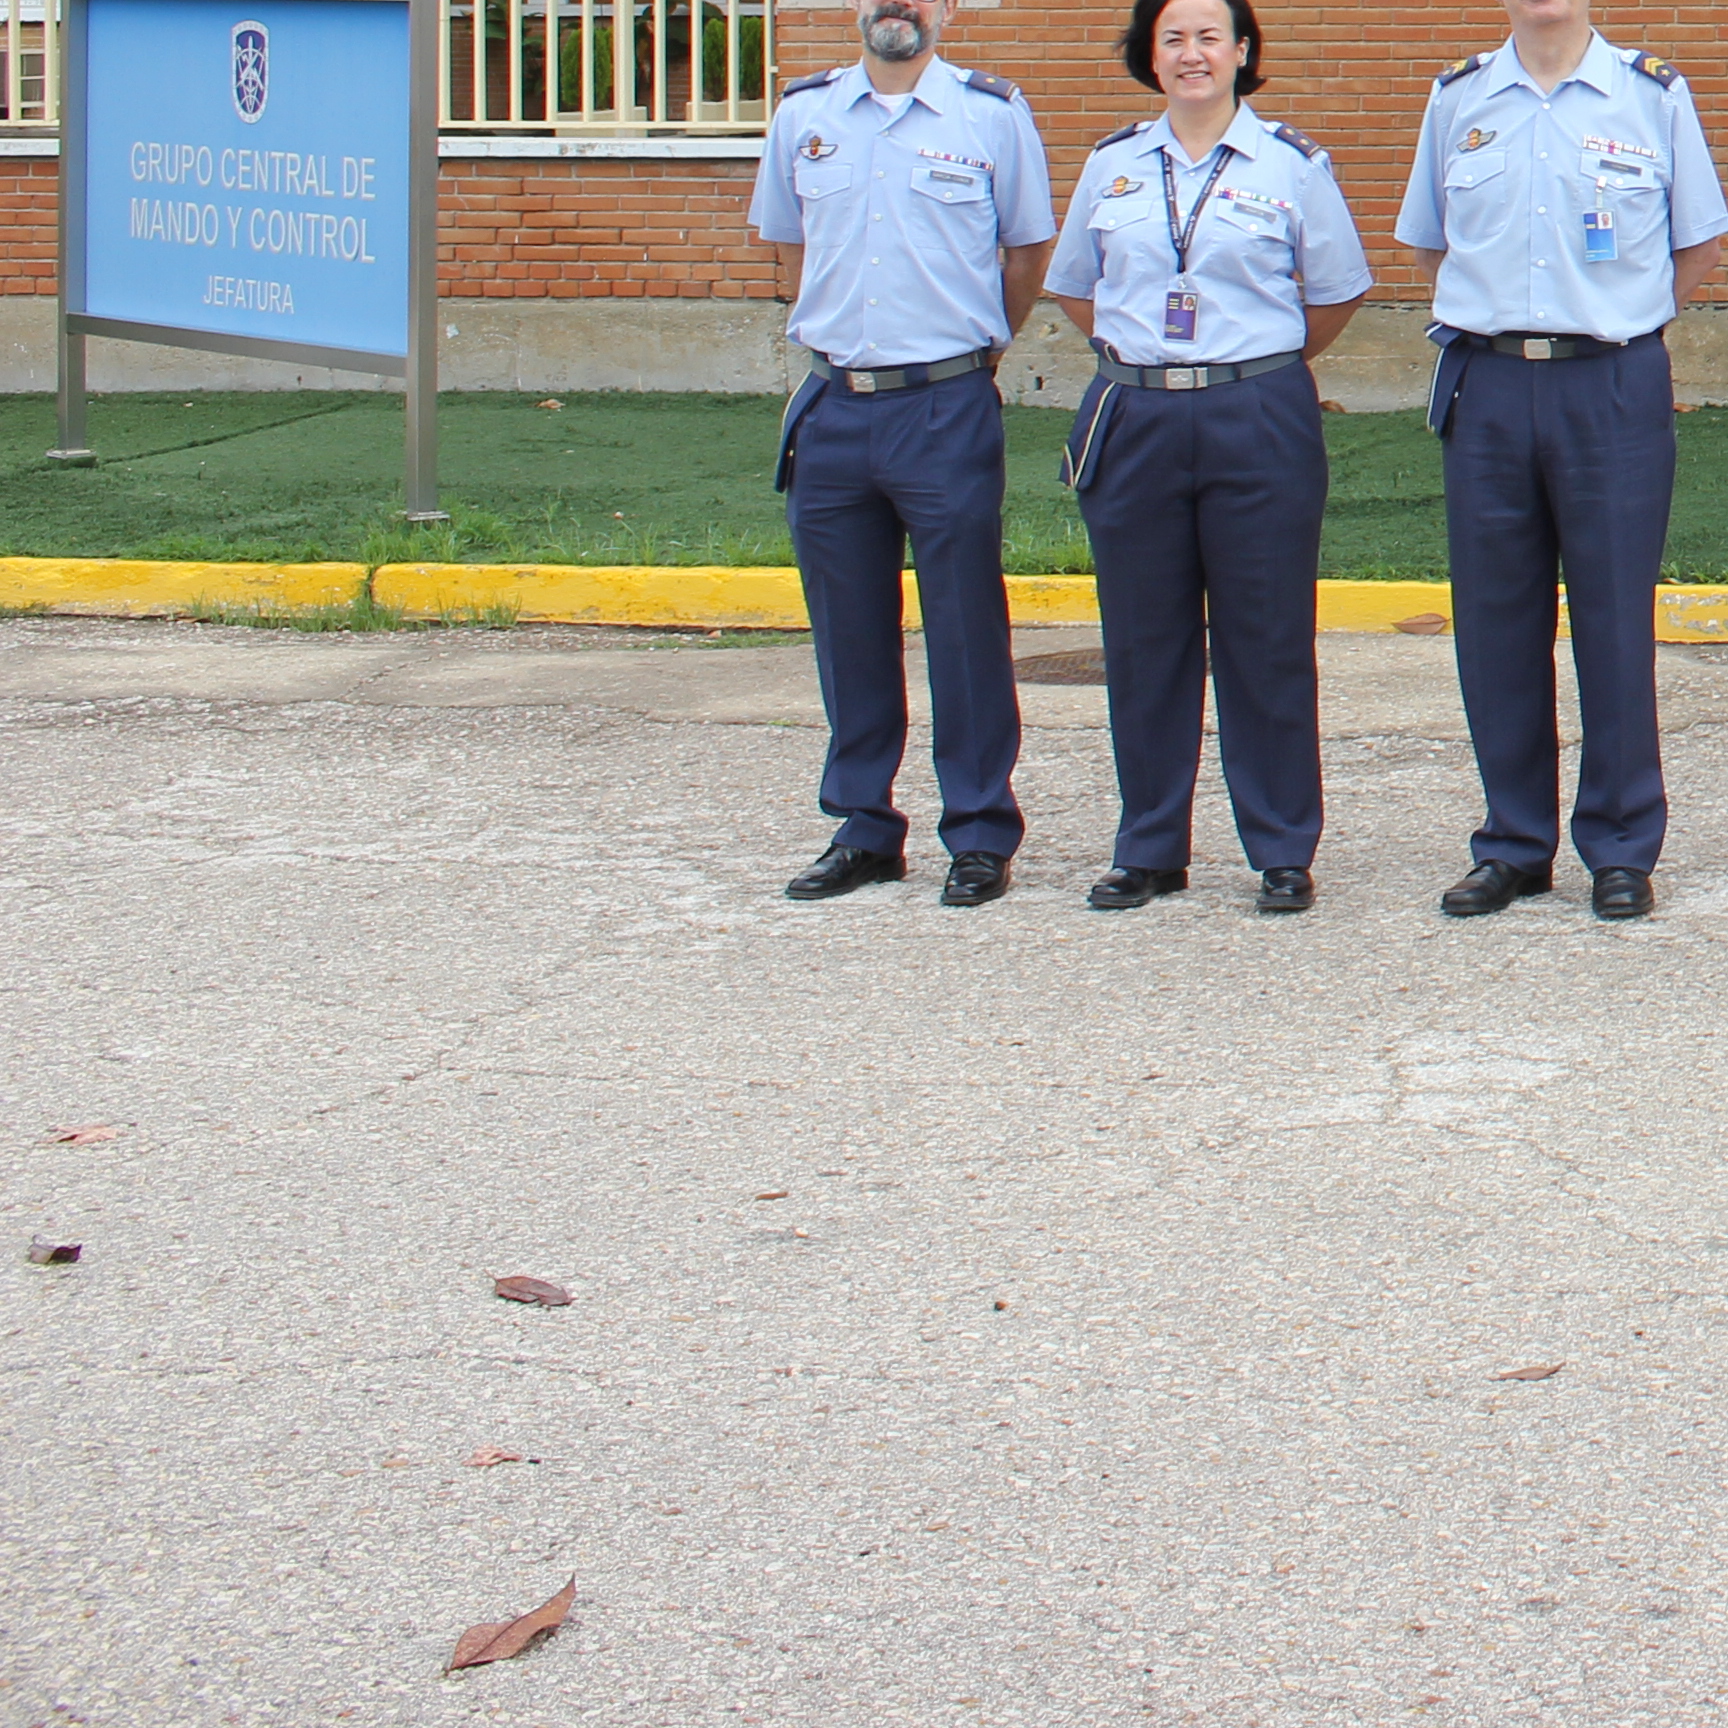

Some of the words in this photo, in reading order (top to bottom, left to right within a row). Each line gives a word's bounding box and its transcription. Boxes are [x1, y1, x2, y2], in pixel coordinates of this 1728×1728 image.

[130, 141, 213, 187] GRUPO
[220, 147, 335, 197] CENTRAL
[341, 156, 376, 201] DE
[130, 197, 219, 247] MANDO
[226, 205, 243, 249] Y
[249, 207, 376, 264] CONTROL
[202, 275, 295, 315] JEFATURA
